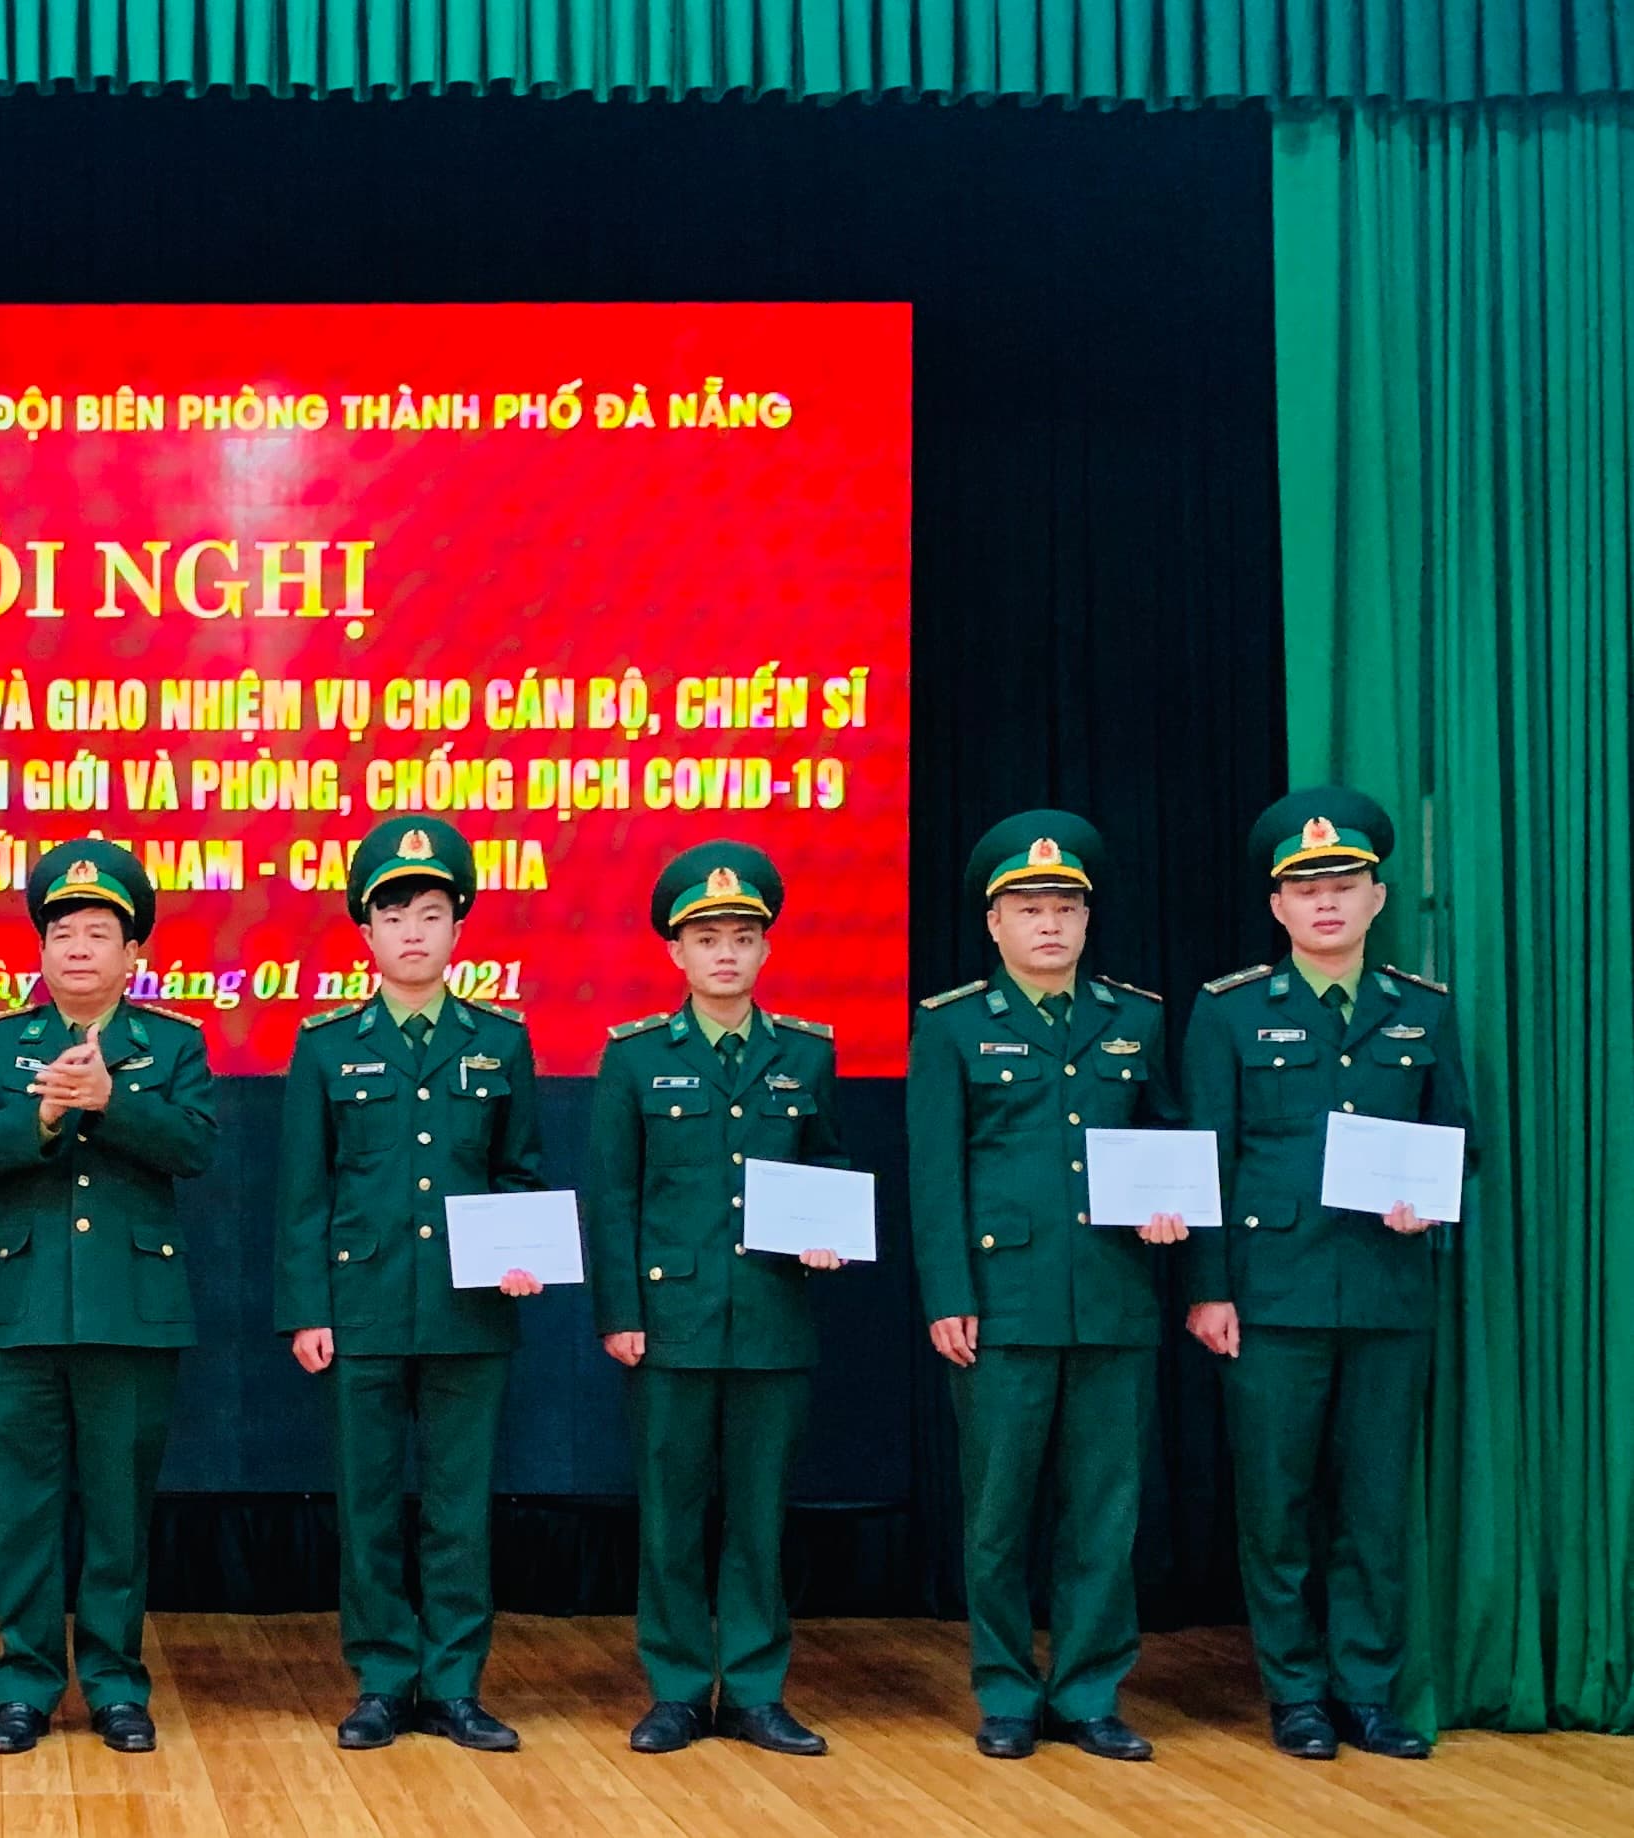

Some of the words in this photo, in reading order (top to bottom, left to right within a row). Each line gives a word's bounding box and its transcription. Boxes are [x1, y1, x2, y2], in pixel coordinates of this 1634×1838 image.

[76, 386, 164, 431] BIÊN
[179, 385, 328, 431] PHÒNG
[341, 384, 479, 431] THÀNH
[494, 379, 582, 430] PHỐ
[595, 384, 655, 429] ĐÀ
[669, 376, 792, 429] NẴNG
[94, 540, 375, 640] NGHỊ
[46, 678, 147, 732] GIAO
[160, 668, 302, 742] NHIỆM
[314, 678, 367, 742] VỤ
[383, 678, 472, 731] CHO
[485, 668, 574, 731] CÁN
[588, 667, 661, 741] BỘ,
[676, 660, 808, 730] CHIẾN
[822, 666, 870, 730] SĨ
[22, 749, 109, 811] GIỚI
[123, 750, 178, 811] VÀ
[192, 749, 351, 816] PHÒNG,
[366, 742, 513, 811] CHỐNG
[526, 757, 630, 822] DỊCH
[643, 757, 845, 810] COVID-19
[145, 839, 244, 891] NAM
[290, 839, 548, 891] CAHIA
[124, 959, 246, 1009] háng
[253, 960, 301, 1000] 01
[443, 960, 521, 1000] 021
